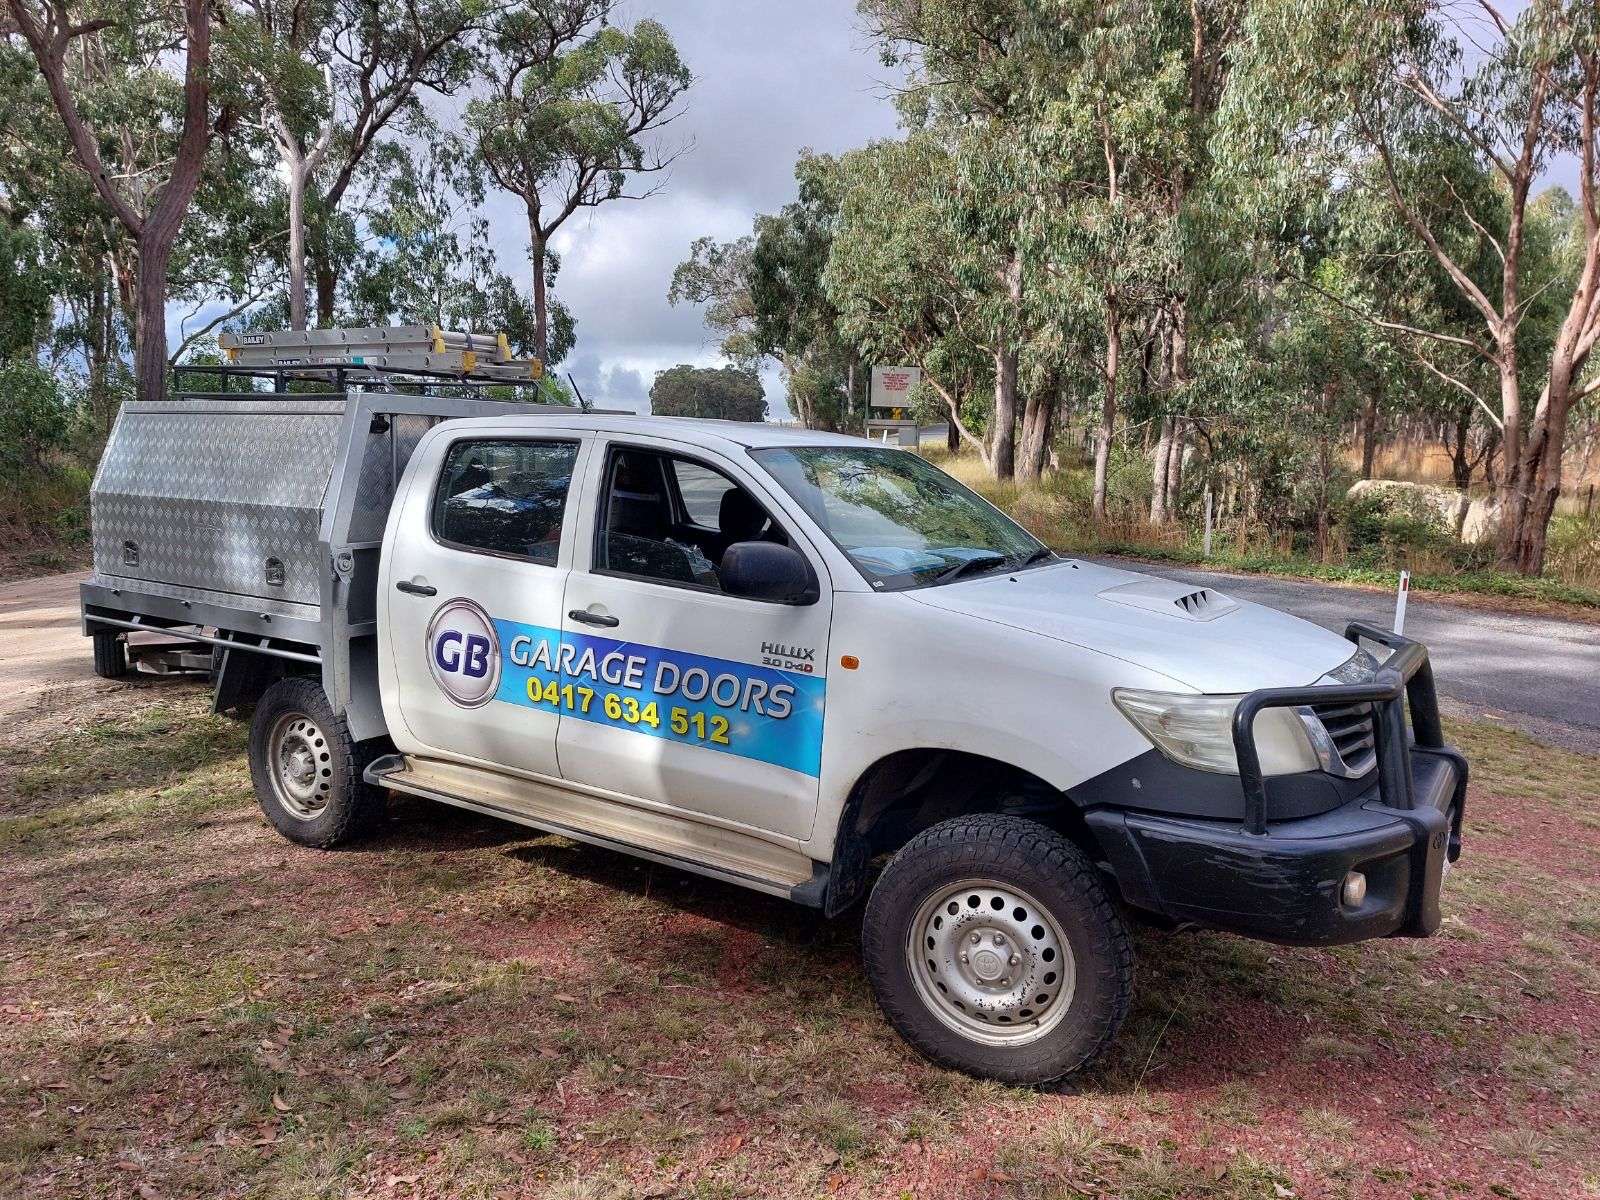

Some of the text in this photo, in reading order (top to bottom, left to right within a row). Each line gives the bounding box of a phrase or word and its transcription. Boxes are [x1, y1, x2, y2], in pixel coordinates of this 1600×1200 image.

[243, 336, 264, 345] BAILEY
[436, 631, 490, 679] GB
[761, 641, 816, 661] HILUX
[510, 635, 796, 720] GARAGE DOORS
[526, 676, 730, 745] 0417 634 512
